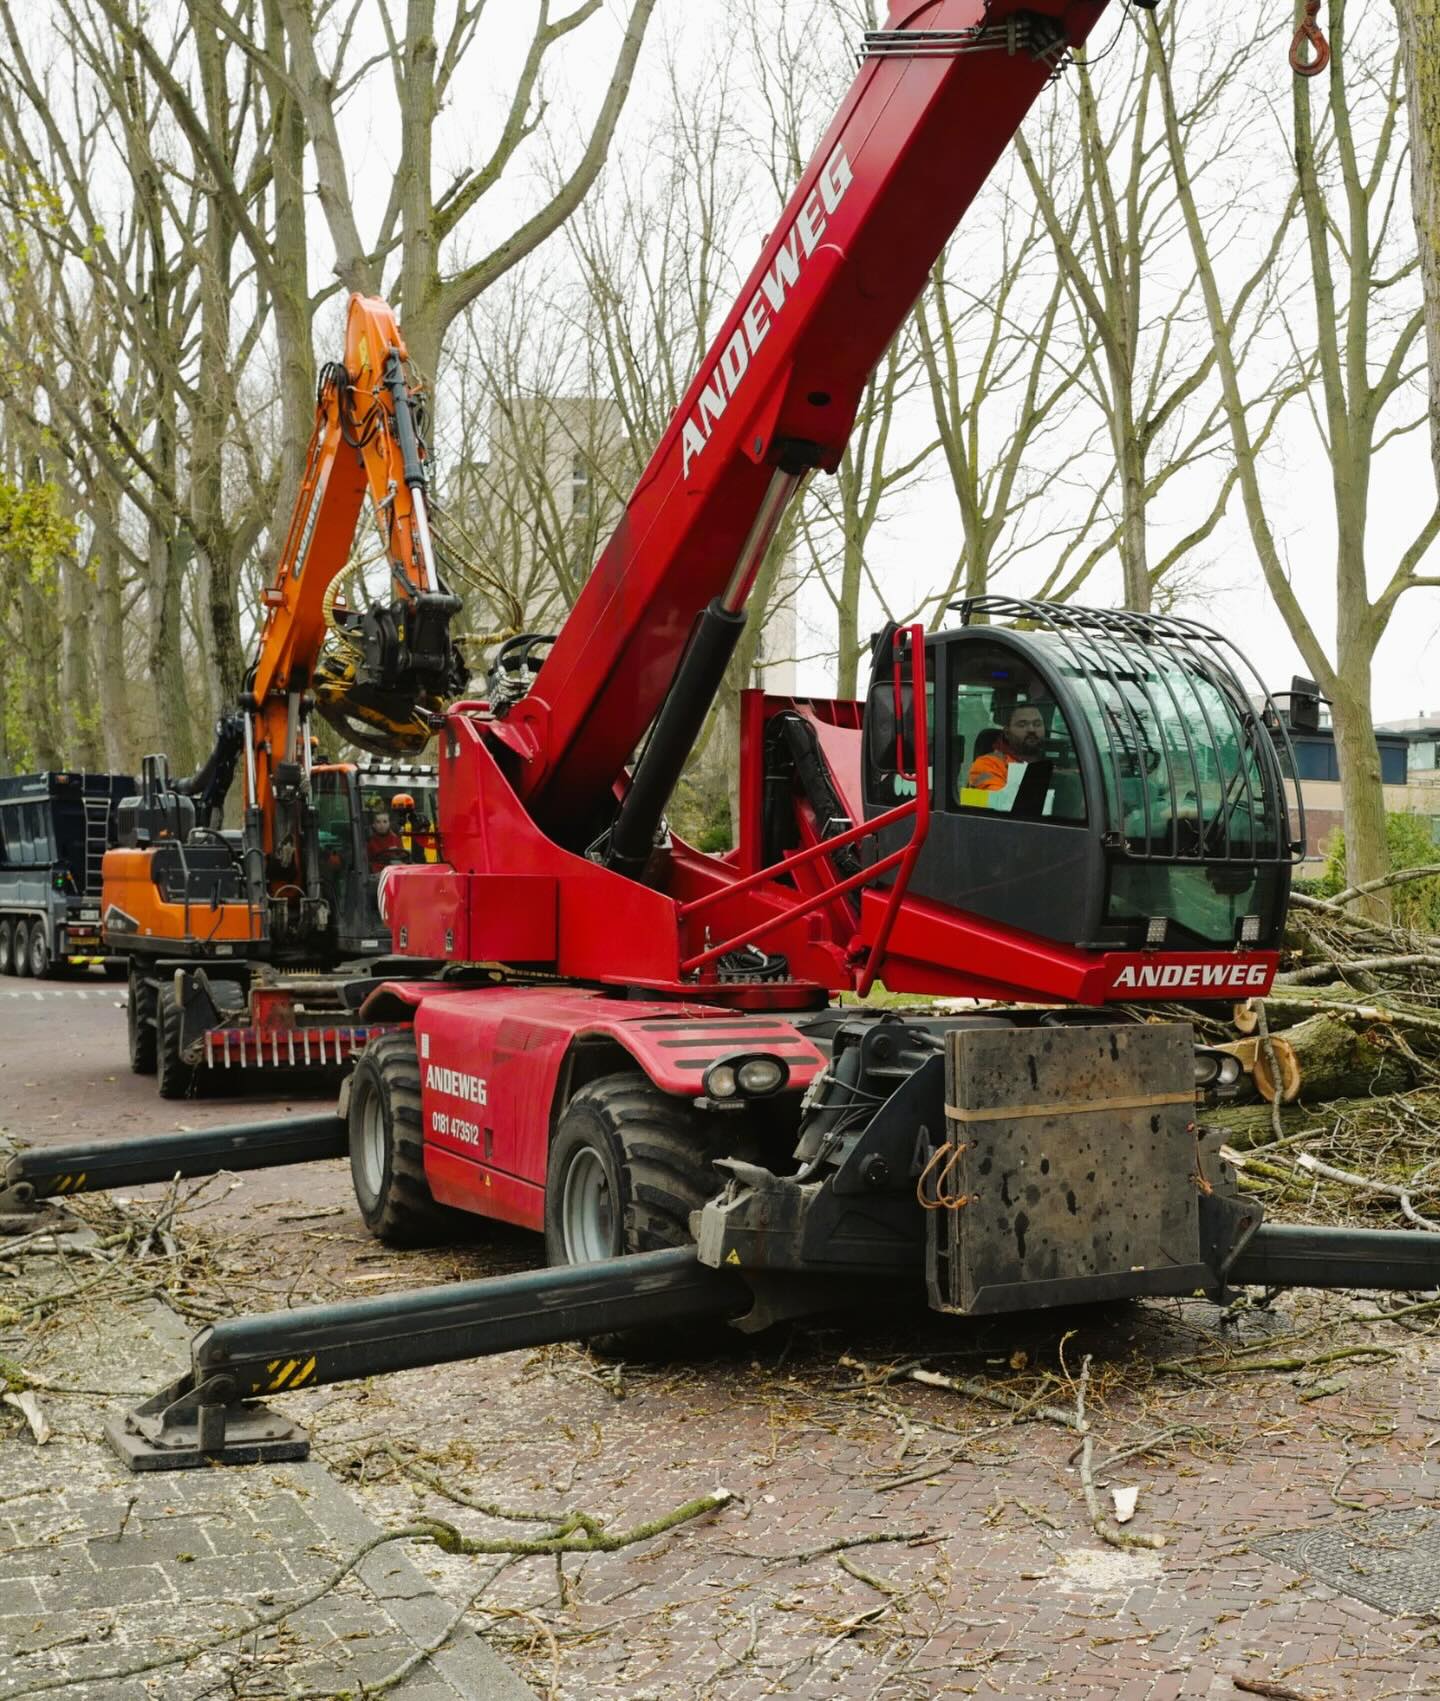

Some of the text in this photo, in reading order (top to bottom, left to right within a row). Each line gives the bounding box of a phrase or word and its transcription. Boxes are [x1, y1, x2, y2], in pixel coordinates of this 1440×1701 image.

[682, 143, 853, 480] ANDEWEG
[1112, 964, 1268, 987] ANDEWEG
[426, 1064, 487, 1105] ANDEWEG
[432, 1112, 479, 1145] 0181 473512
